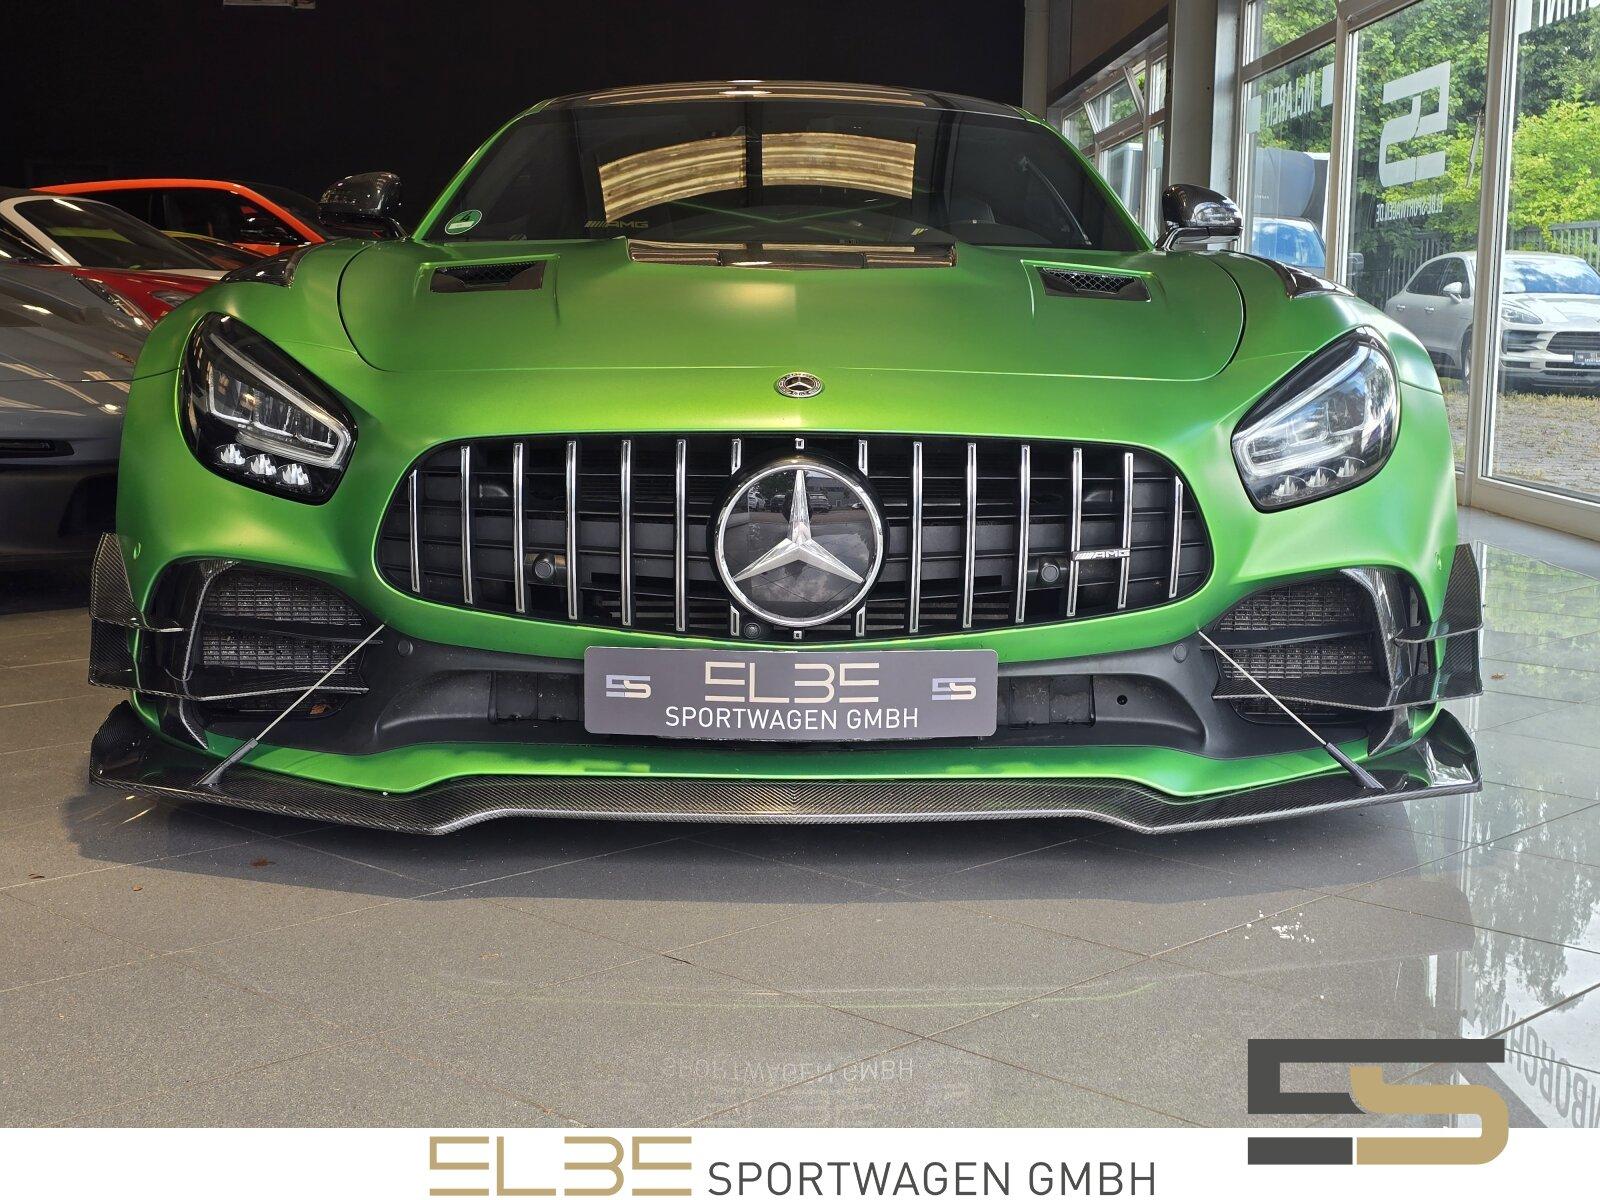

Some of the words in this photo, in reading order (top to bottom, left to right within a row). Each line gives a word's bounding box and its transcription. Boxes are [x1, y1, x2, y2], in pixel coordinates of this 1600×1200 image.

[705, 661, 880, 704] ELBE
[665, 706, 837, 730] SPORTWAGEN
[846, 707, 919, 729] GMBH
